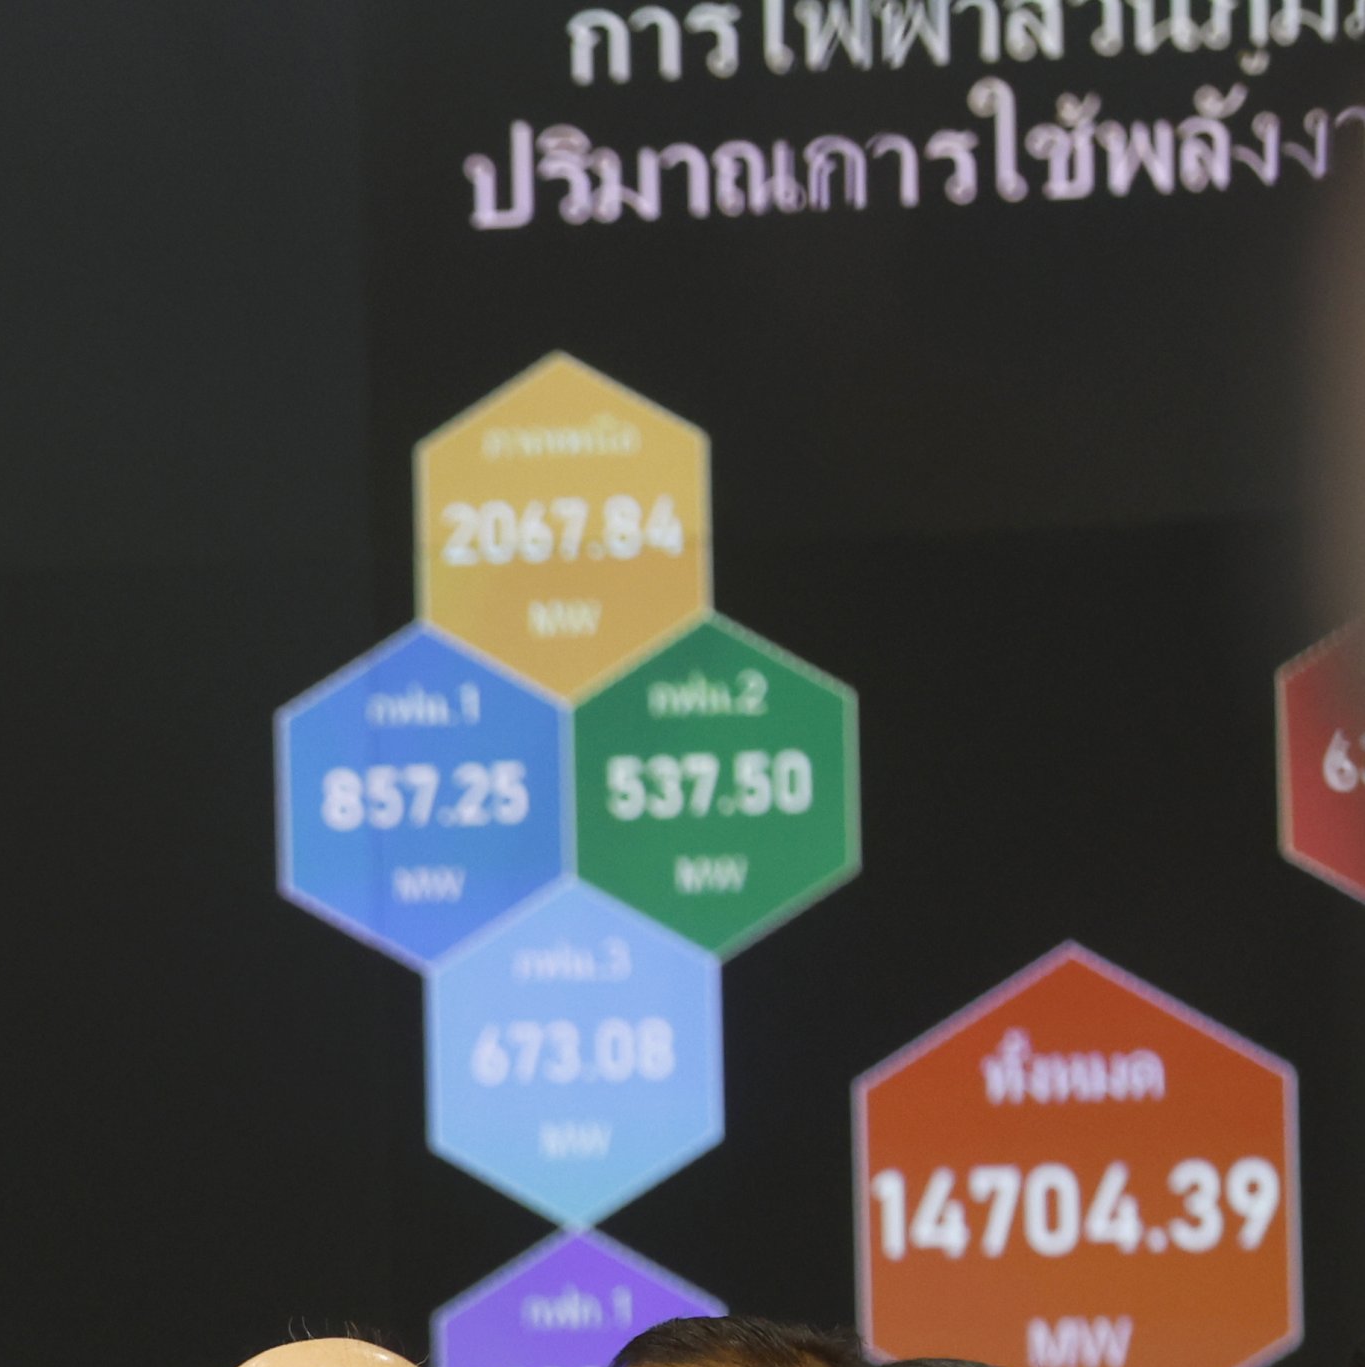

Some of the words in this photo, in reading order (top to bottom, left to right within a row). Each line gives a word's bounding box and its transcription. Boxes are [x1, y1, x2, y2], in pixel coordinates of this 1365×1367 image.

[442, 495, 683, 566] 2067.84
[321, 761, 530, 832] 857.25
[605, 749, 812, 820] 537.50
[471, 1016, 676, 1087] 673.08
[981, 1027, 1166, 1105] ทั้งหมด
[873, 1156, 1280, 1260] 14704.39
